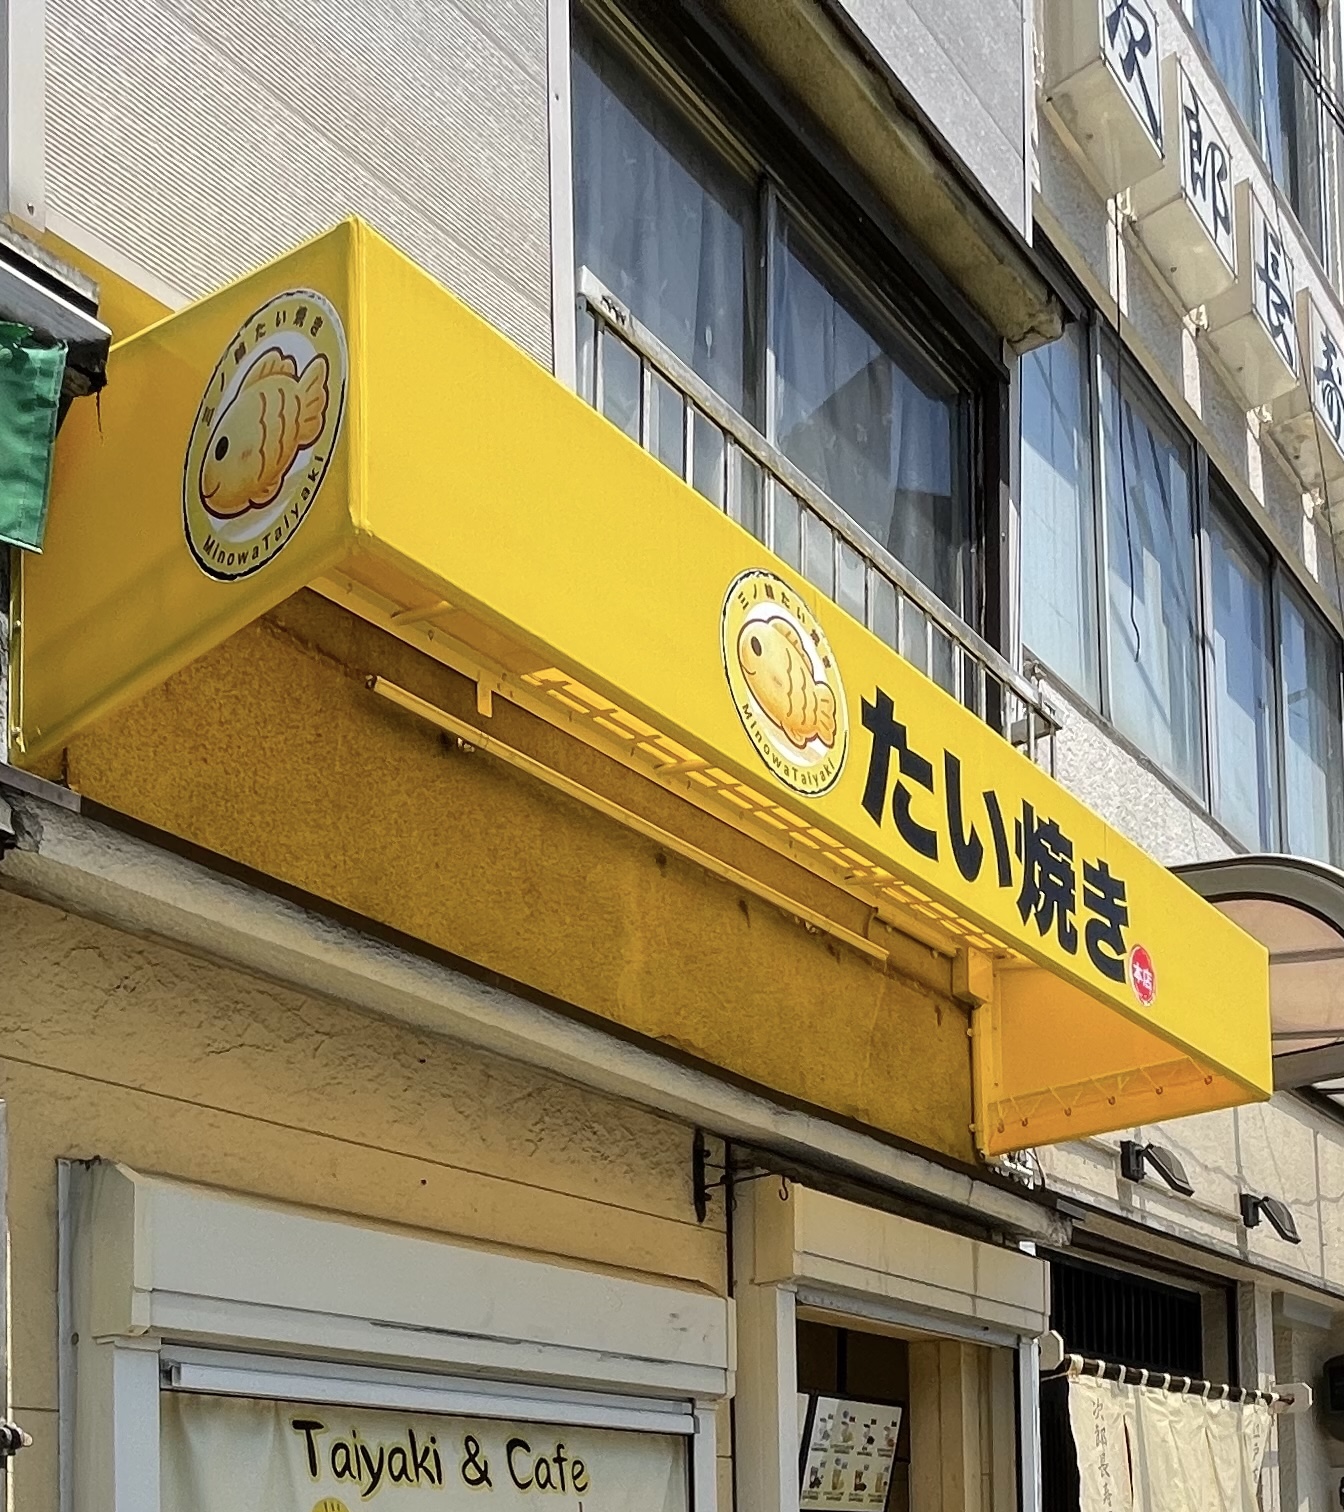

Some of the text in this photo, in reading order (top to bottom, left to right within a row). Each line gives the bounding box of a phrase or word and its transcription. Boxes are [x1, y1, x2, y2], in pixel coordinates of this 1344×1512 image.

[861, 685, 1129, 984] たい焼き
[1133, 961, 1153, 991] 本店
[291, 1419, 590, 1497] Taiyaki & Cafe
